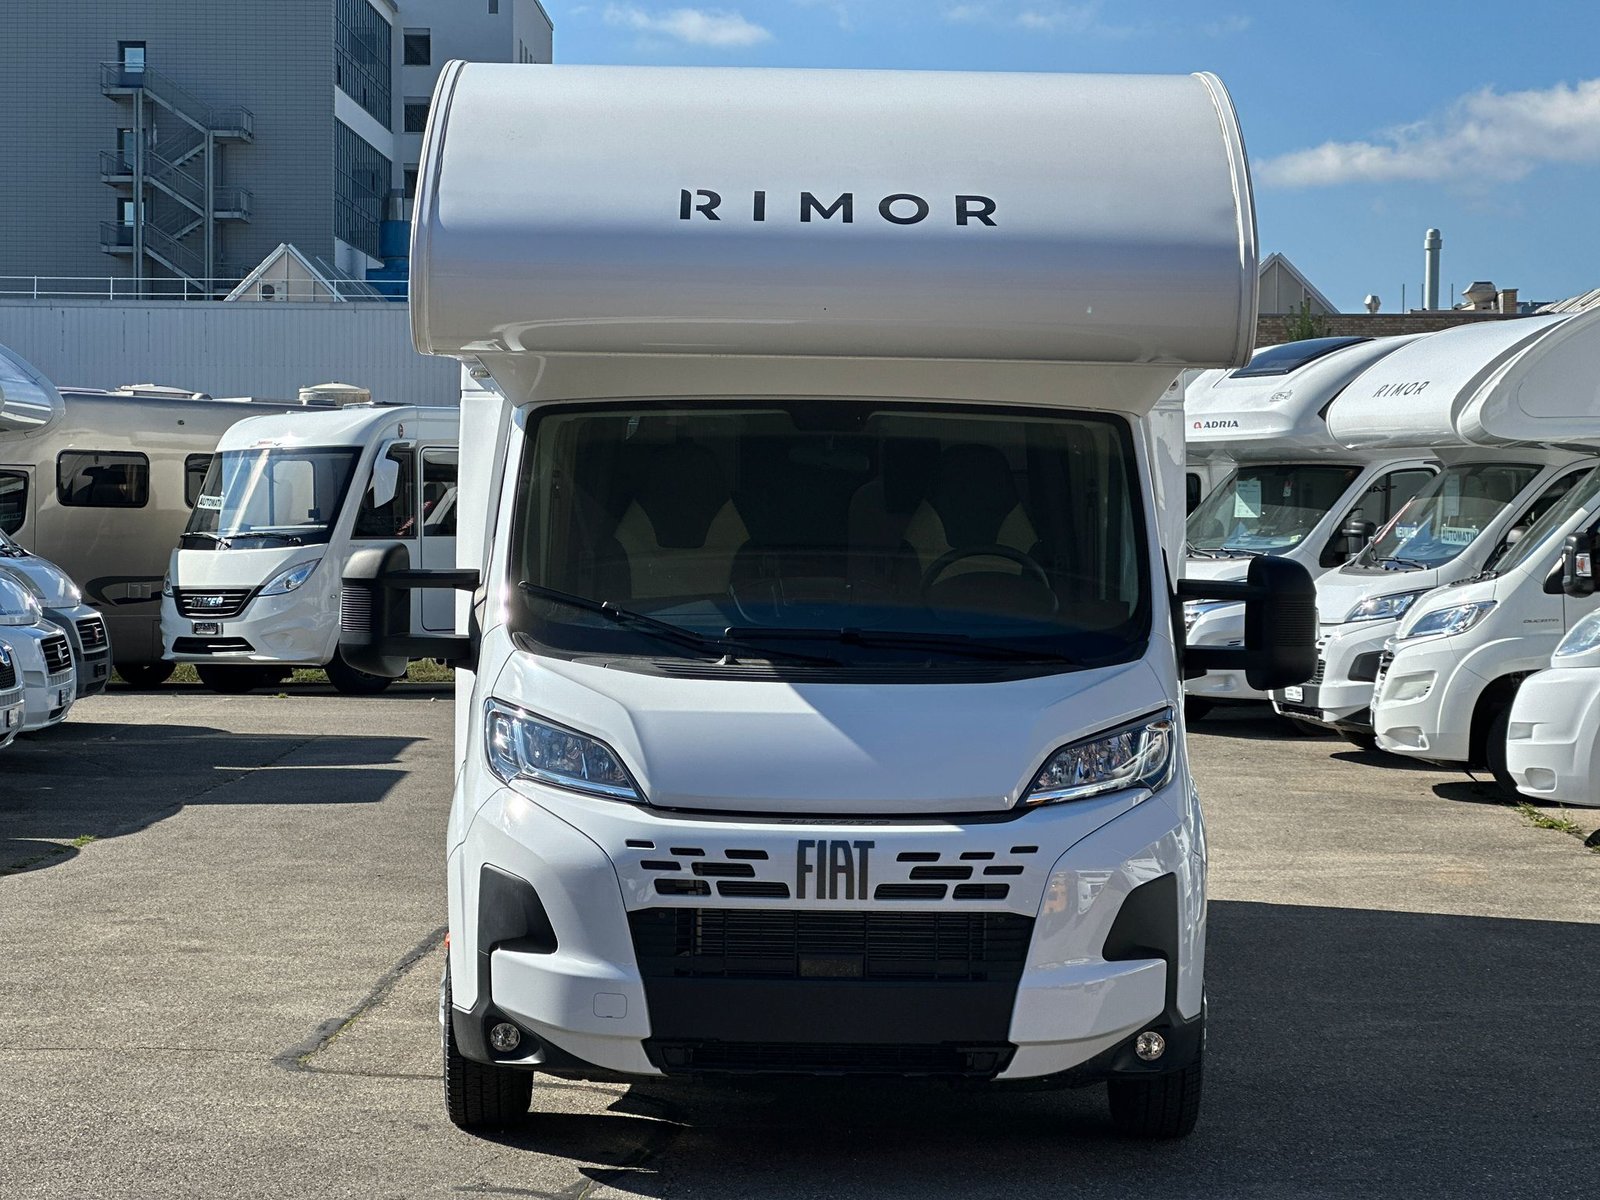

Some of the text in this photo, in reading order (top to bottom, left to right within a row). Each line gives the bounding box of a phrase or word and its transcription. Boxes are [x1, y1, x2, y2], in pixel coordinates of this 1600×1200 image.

[679, 188, 998, 227] RIMOR
[1372, 380, 1431, 398] RIMOR
[1203, 420, 1239, 429] ADRIA
[796, 839, 875, 900] FIAT
